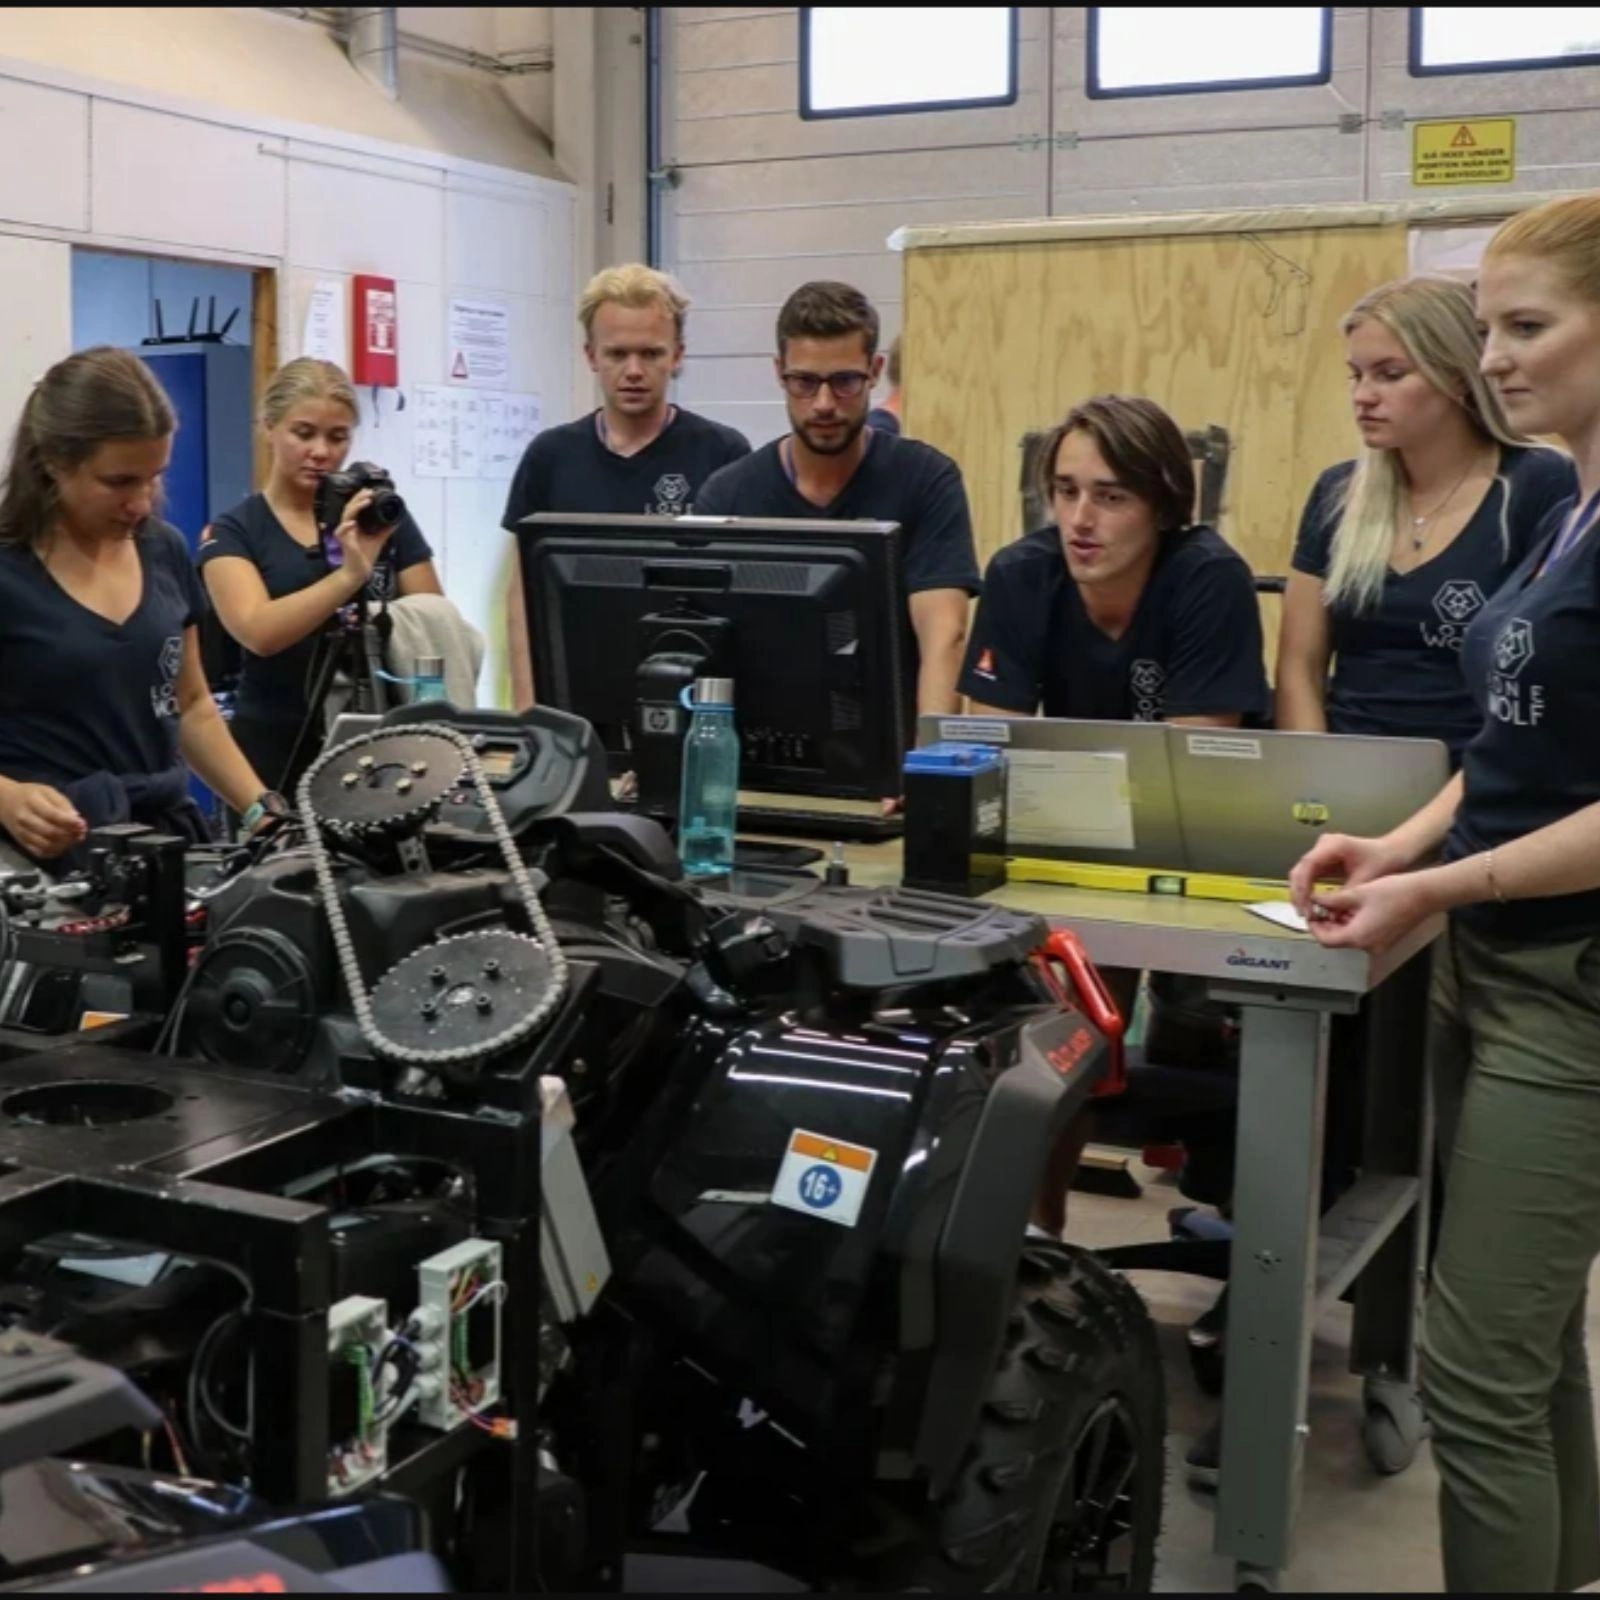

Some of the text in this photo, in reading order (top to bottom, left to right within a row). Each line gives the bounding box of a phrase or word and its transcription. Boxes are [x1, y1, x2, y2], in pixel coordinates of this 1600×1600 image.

[1423, 633, 1464, 653] WO
[1225, 953, 1290, 971] GIGANT
[803, 1171, 837, 1201] 16+
